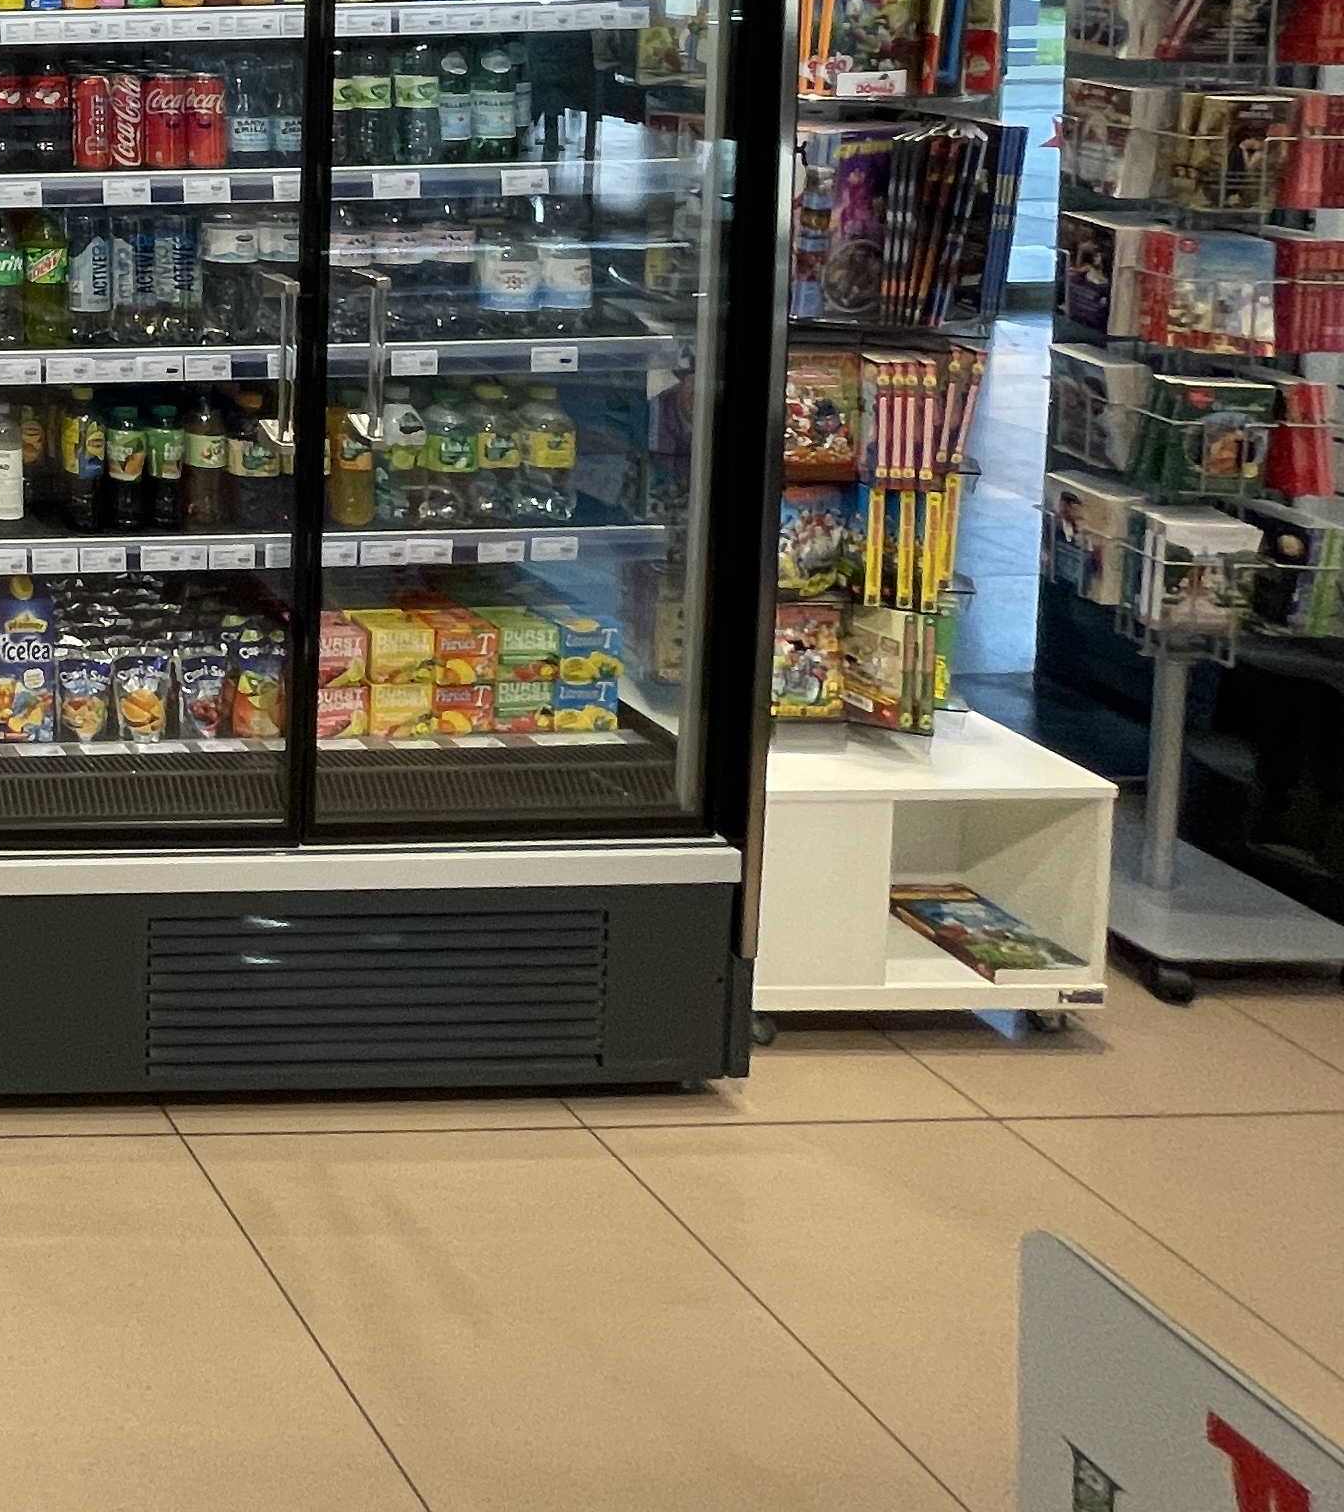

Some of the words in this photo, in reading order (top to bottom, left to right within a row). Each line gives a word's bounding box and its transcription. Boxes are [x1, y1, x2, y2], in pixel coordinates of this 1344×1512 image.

[503, 628, 557, 643] DURST
[319, 638, 362, 649] URST
[498, 681, 552, 695] DURST
[319, 689, 364, 701] URST
